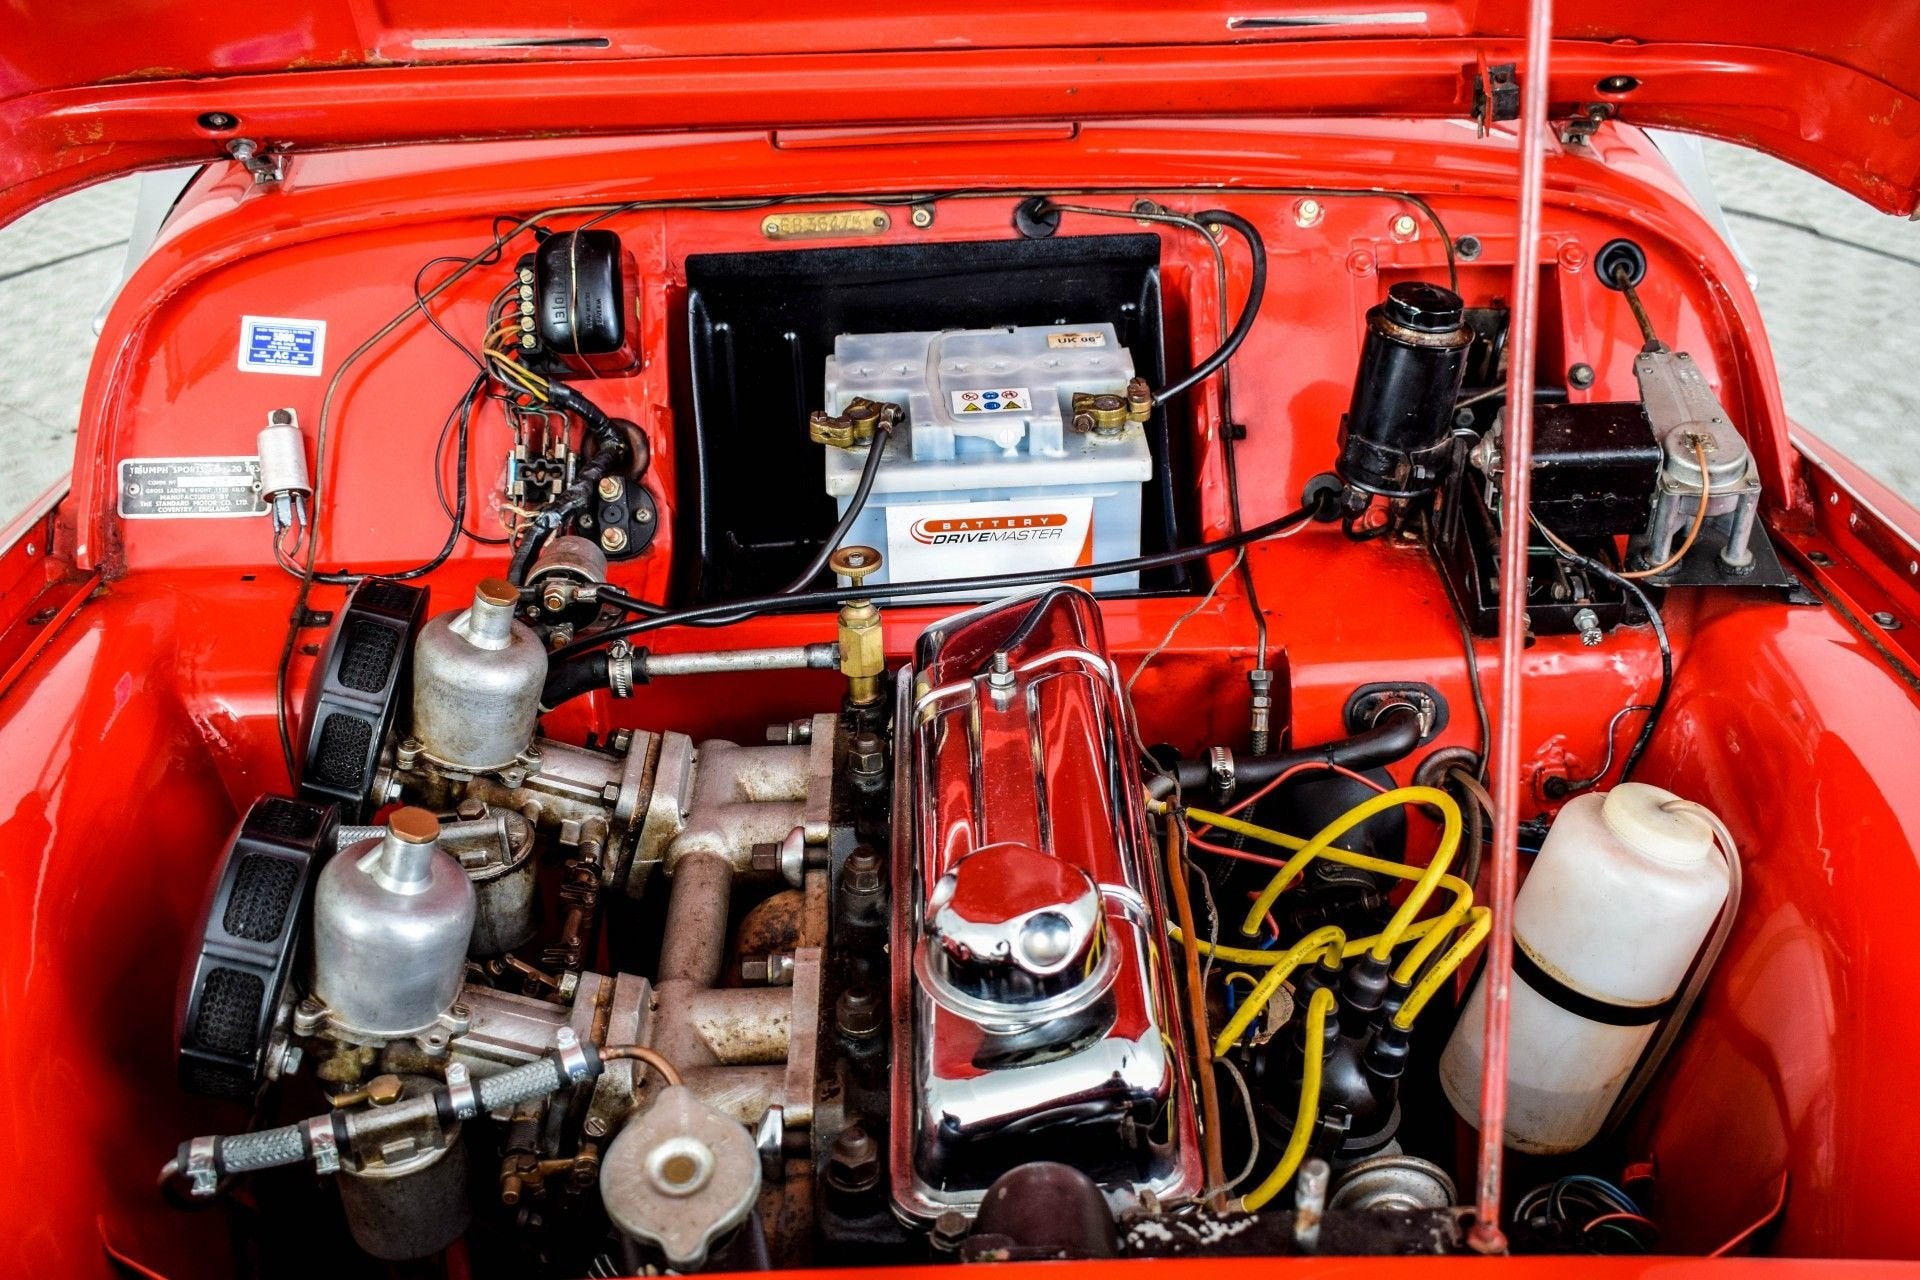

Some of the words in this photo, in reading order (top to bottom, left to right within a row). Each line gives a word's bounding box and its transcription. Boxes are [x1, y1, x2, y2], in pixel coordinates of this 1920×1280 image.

[273, 351, 289, 360] AC
[130, 465, 169, 475] TRIUMPH
[159, 493, 216, 501] MANUFACTURED
[155, 499, 190, 507] STANDARD
[942, 517, 1049, 530] BATTERY
[933, 528, 1063, 545] DRIVEMASTER
